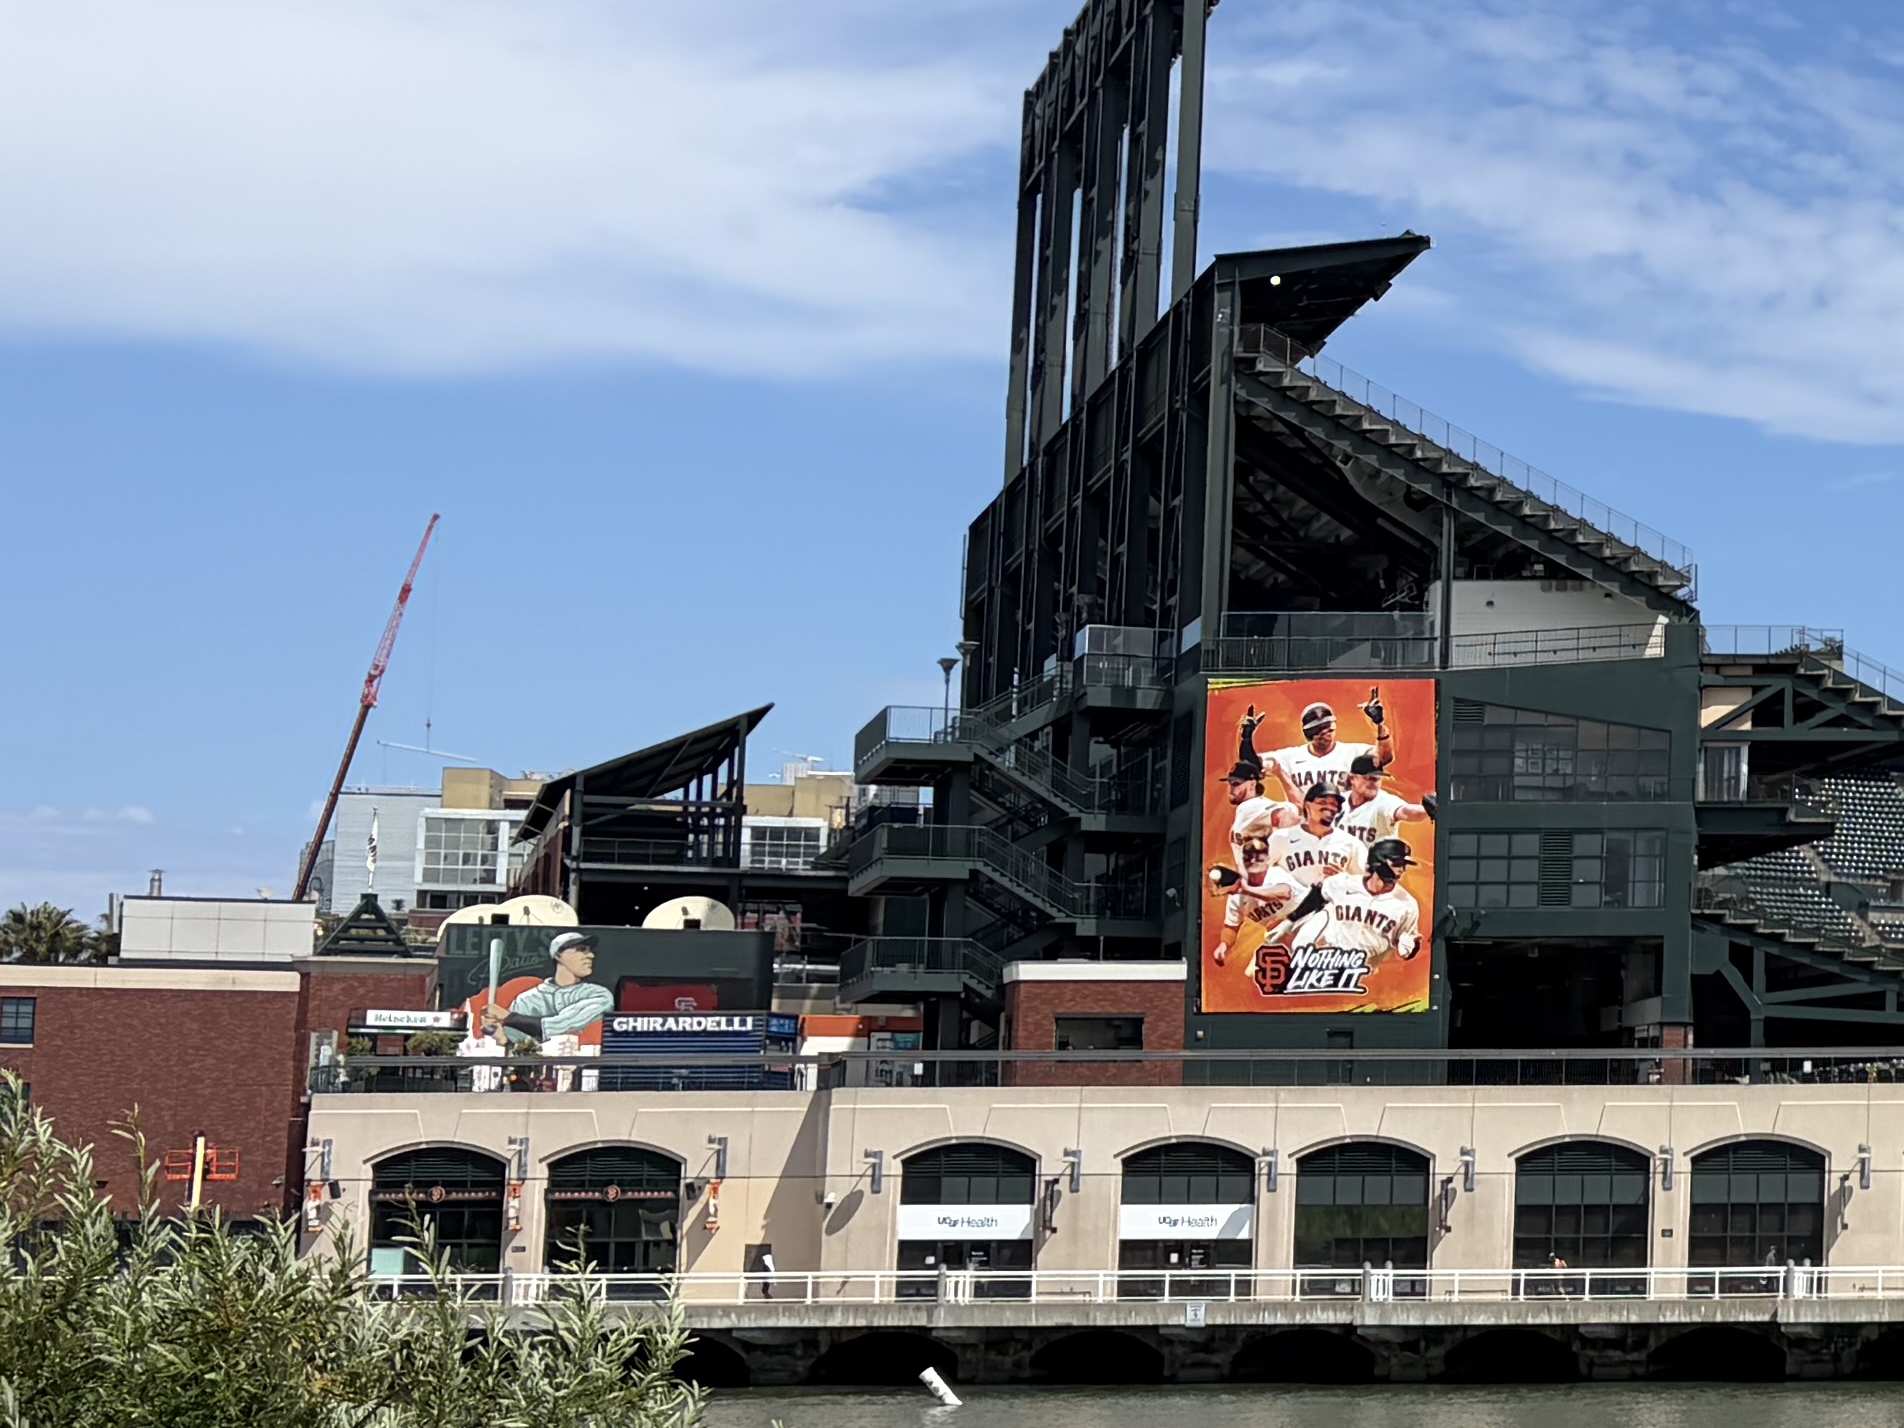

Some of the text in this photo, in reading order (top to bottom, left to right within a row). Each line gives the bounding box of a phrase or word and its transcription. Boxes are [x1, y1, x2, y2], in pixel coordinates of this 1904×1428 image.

[1335, 904, 1397, 934] GIANTS
[1289, 946, 1365, 969] NOTHING
[1286, 967, 1369, 990] LIKE IT
[613, 1016, 754, 1032] GHIRARDELLI
[960, 1216, 998, 1228] Health
[1180, 1215, 1218, 1228] Health
